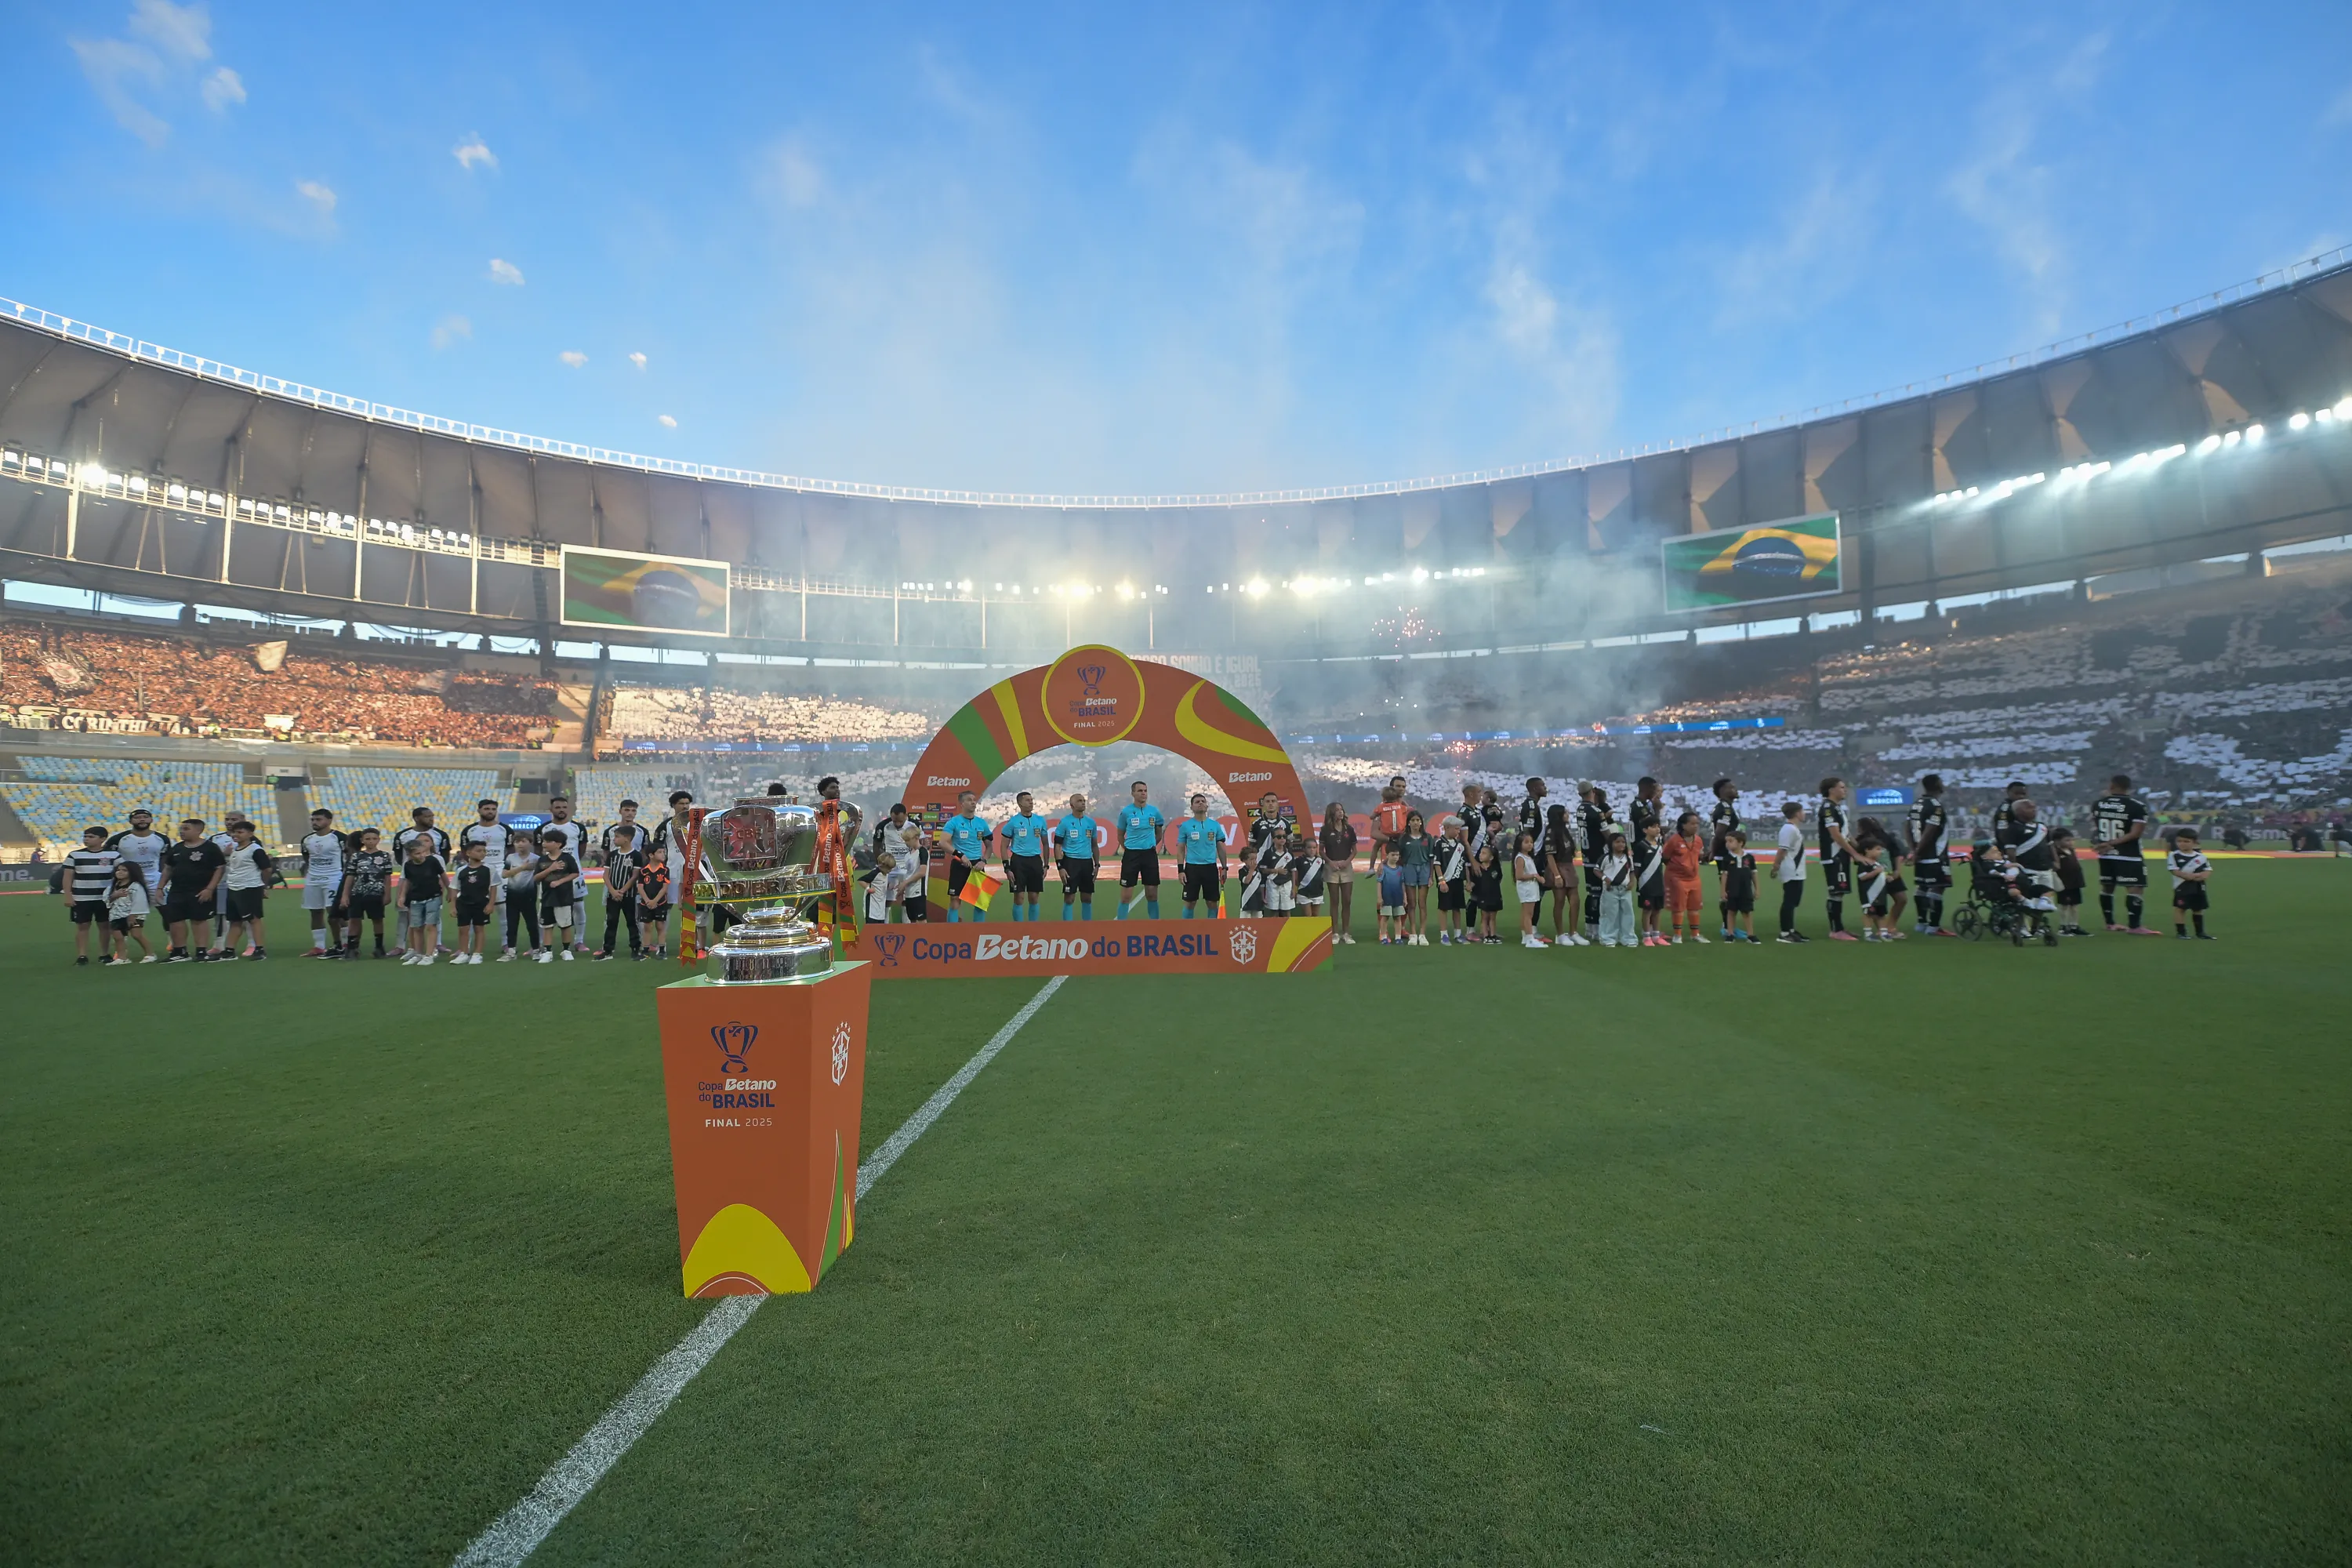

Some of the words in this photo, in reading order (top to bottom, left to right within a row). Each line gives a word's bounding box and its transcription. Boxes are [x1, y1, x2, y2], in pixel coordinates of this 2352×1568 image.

[1226, 655, 1261, 673] IGUAL
[1079, 706, 1116, 717] BRASIL
[927, 776, 971, 786] Betano
[1229, 772, 1272, 782] Betano
[1392, 810, 1397, 832] 1
[2098, 818, 2125, 842] 96
[822, 833, 833, 863] Betano
[828, 825, 833, 833] do
[834, 844, 840, 852] do
[687, 839, 698, 869] Betano
[835, 852, 845, 882] Betano
[839, 881, 848, 898] Copa
[913, 938, 971, 964] Copa
[975, 935, 1088, 960] Betano
[1091, 936, 1120, 957] do
[1127, 935, 1218, 956] BRASIL
[699, 1081, 723, 1092] Copa
[725, 1078, 777, 1091] Betano
[699, 1092, 711, 1102] do
[713, 1093, 775, 1109] BRASIL
[705, 1118, 741, 1127] FINAL
[746, 1117, 772, 1127] 2025
